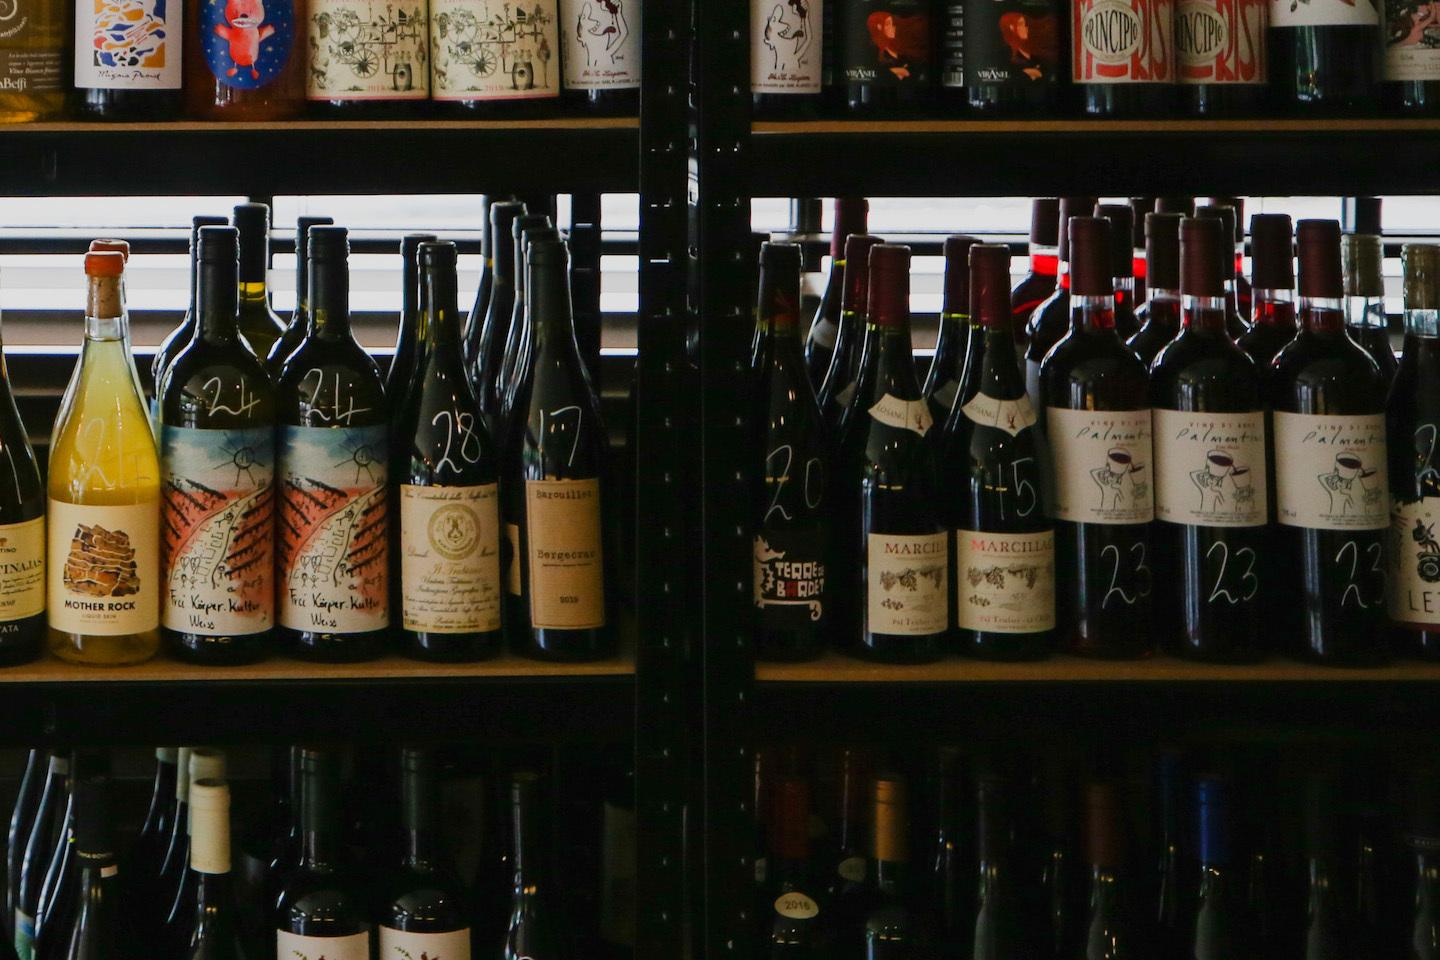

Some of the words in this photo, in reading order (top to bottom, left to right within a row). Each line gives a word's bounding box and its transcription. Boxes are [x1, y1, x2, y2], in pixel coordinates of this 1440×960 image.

[1085, 9, 1138, 54] PRINCIPIO
[202, 375, 261, 419] 24
[303, 367, 374, 426] 24
[431, 405, 482, 474] 28
[538, 406, 583, 468] 17
[763, 444, 826, 522] 20
[997, 456, 1037, 521] 15
[1100, 541, 1152, 609] 23
[1206, 540, 1259, 604] 23
[1335, 540, 1387, 609] 23
[64, 600, 105, 611] MOTHER
[108, 600, 136, 611] ROCK
